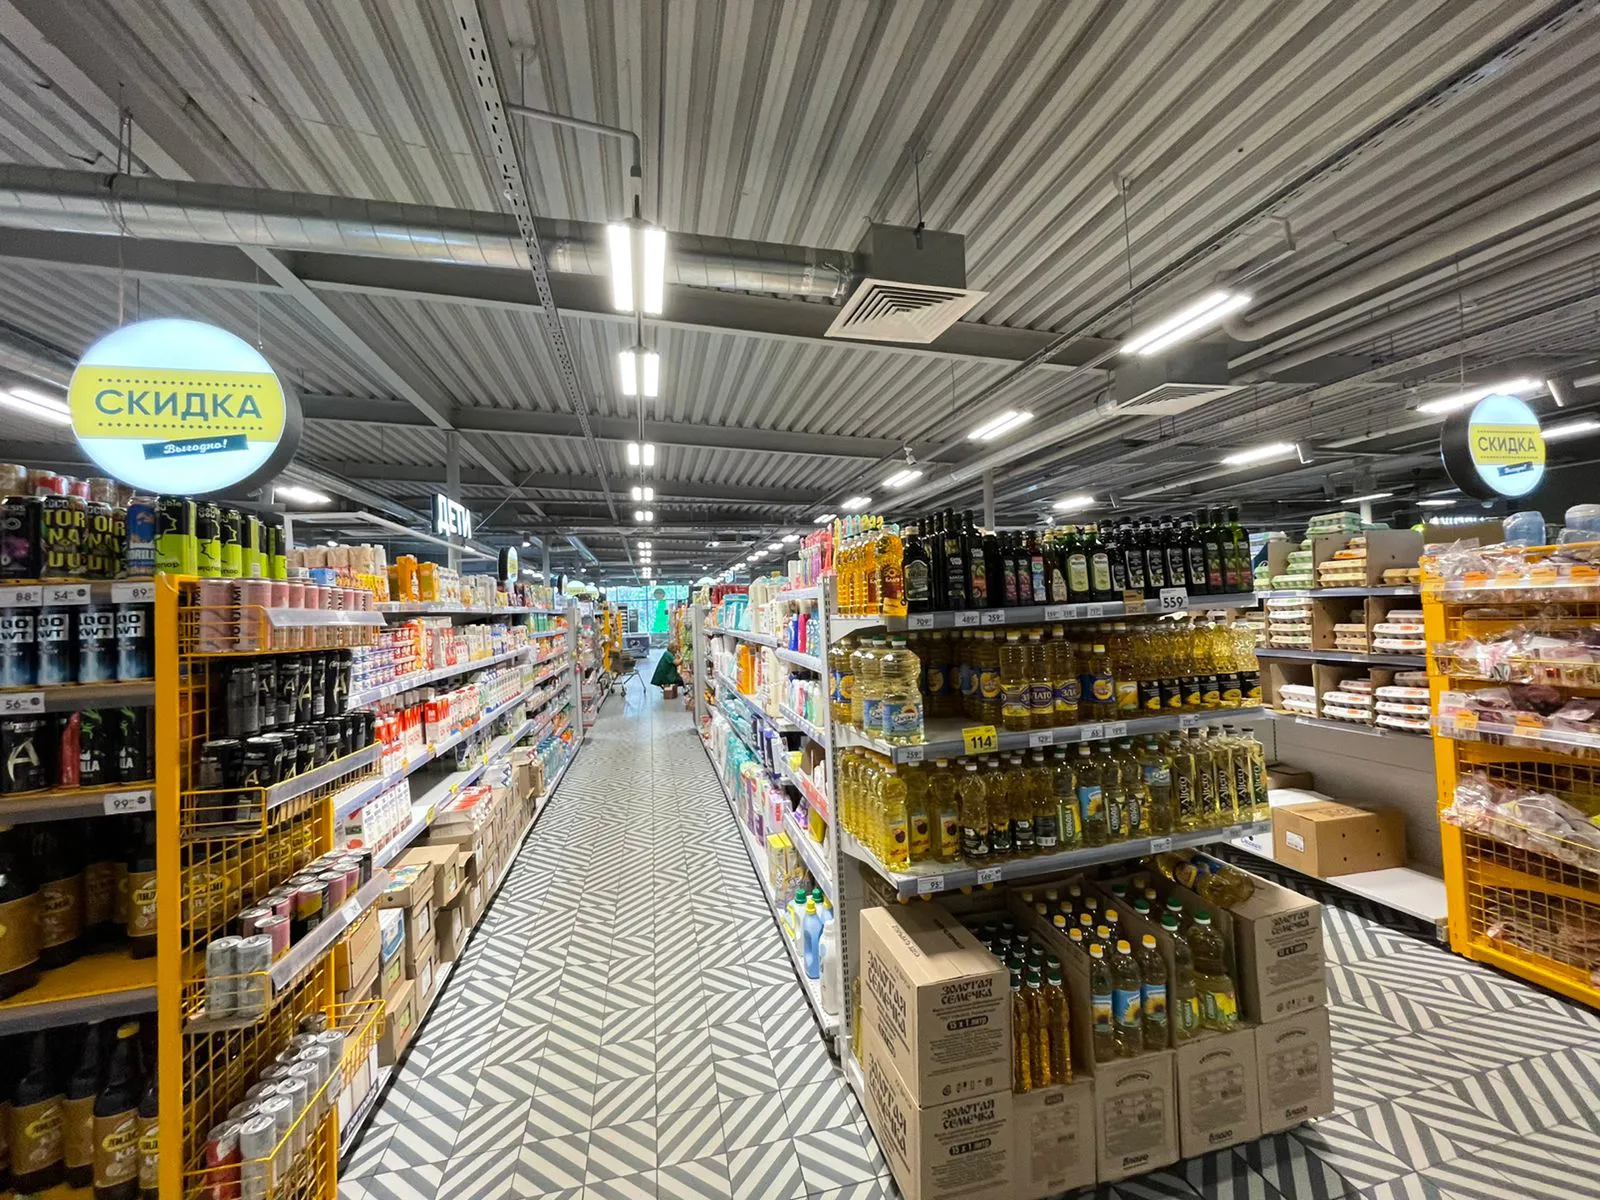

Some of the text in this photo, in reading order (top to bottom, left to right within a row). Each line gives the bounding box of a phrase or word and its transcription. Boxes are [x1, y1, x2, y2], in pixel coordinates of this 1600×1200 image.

[95, 389, 263, 421] СКИДКА
[163, 438, 228, 455] Выгодно!
[1477, 436, 1537, 455] СКИДКА
[437, 493, 472, 540] ДЕТИ
[1163, 596, 1184, 609] 559
[970, 735, 992, 749] 114
[113, 799, 129, 809] 99
